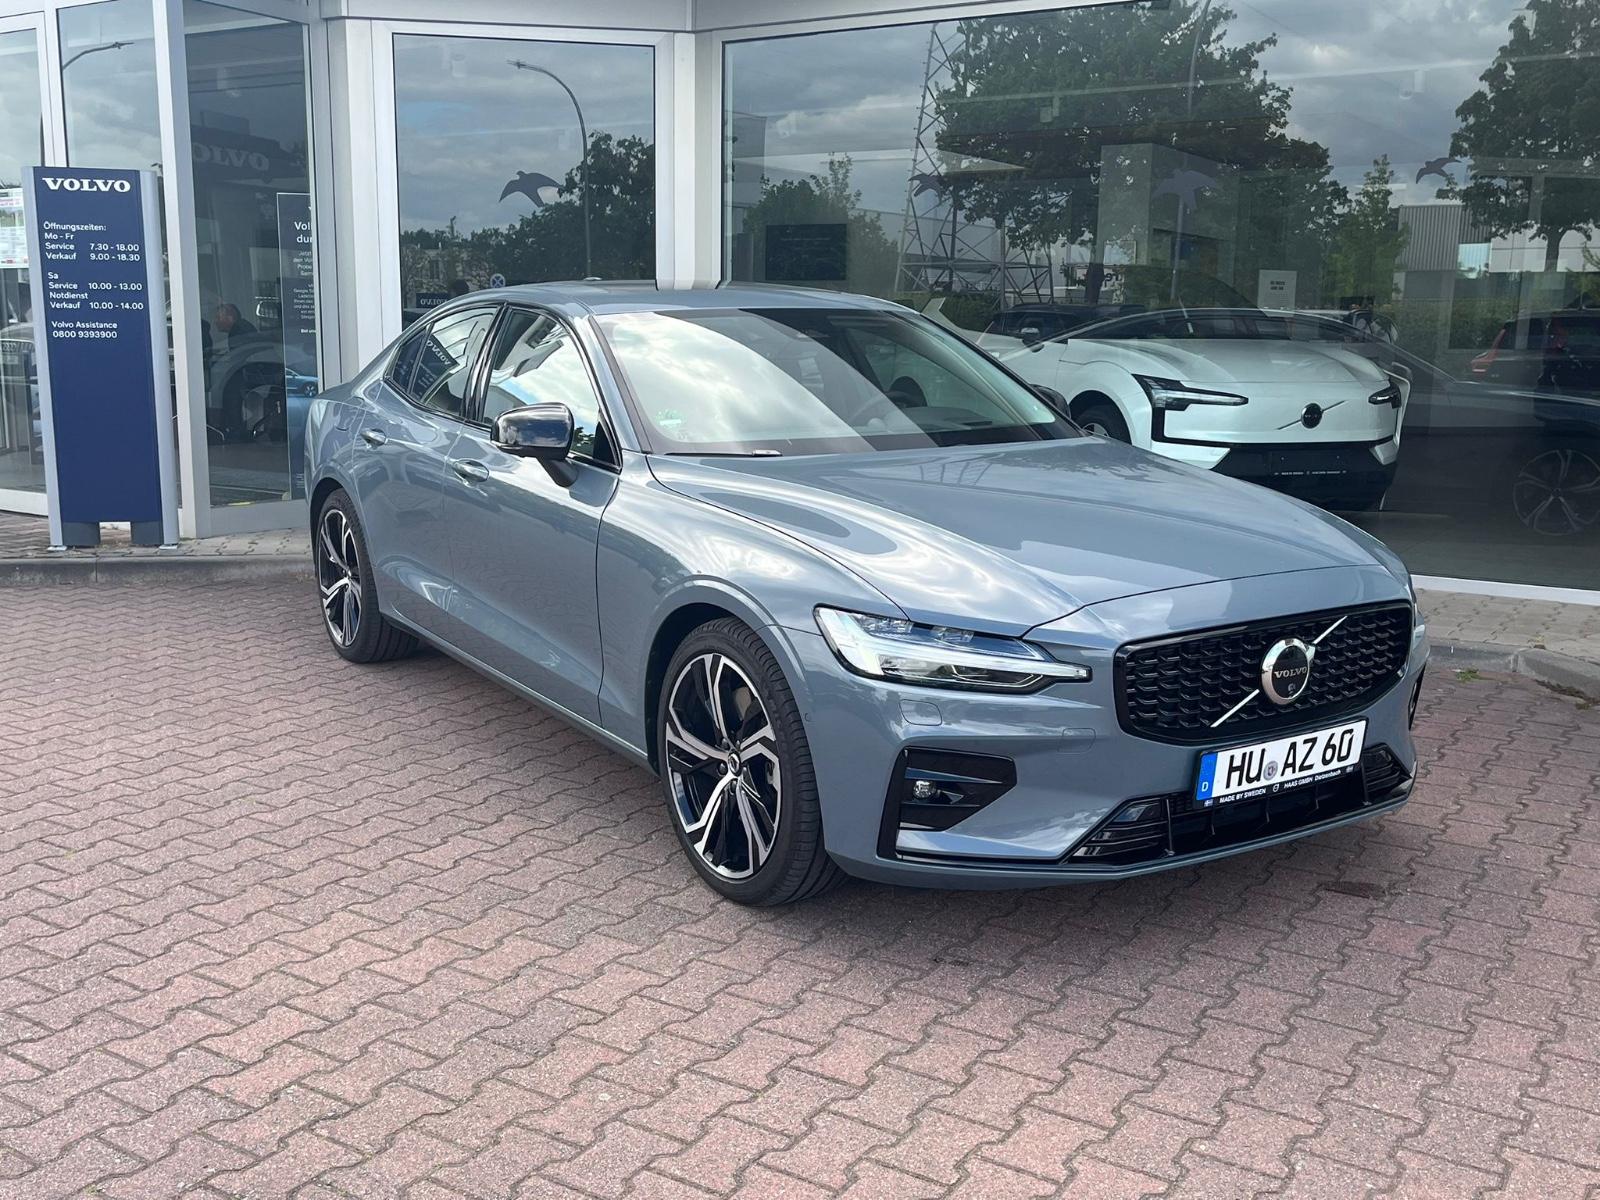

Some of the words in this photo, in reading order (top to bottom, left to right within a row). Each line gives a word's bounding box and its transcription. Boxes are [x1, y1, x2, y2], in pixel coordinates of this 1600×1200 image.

[192, 142, 270, 171] OLVO
[42, 177, 131, 192] VOLVO
[43, 221, 107, 232] Öffnungszeiten:
[294, 221, 312, 230] Vol
[44, 232, 58, 240] Mo
[45, 242, 75, 250] Service
[89, 243, 109, 251] 7.30
[116, 243, 140, 252] 18.00
[46, 252, 77, 260] Verkauf
[90, 253, 110, 261] 9.00
[117, 253, 140, 261] 18.30
[48, 282, 78, 290] Service
[88, 282, 112, 290] 10.00
[119, 283, 142, 291] 13.00
[49, 291, 88, 299] Notdienst
[50, 301, 81, 309] Verkauf
[89, 302, 113, 310] 10.00
[120, 302, 144, 310] 14.00
[51, 320, 74, 328] Volvo
[75, 321, 117, 329] Assistance
[52, 330, 76, 338] 0800
[78, 331, 117, 339] 9393900
[1274, 666, 1307, 679] VOLVO
[1201, 781, 1209, 792] D
[1225, 748, 1266, 789] HU
[1280, 736, 1318, 777] AZ
[1321, 728, 1354, 766] 60
[1219, 794, 1236, 803] MADE
[1236, 792, 1244, 800] BY
[1244, 788, 1267, 798] SWEDEN
